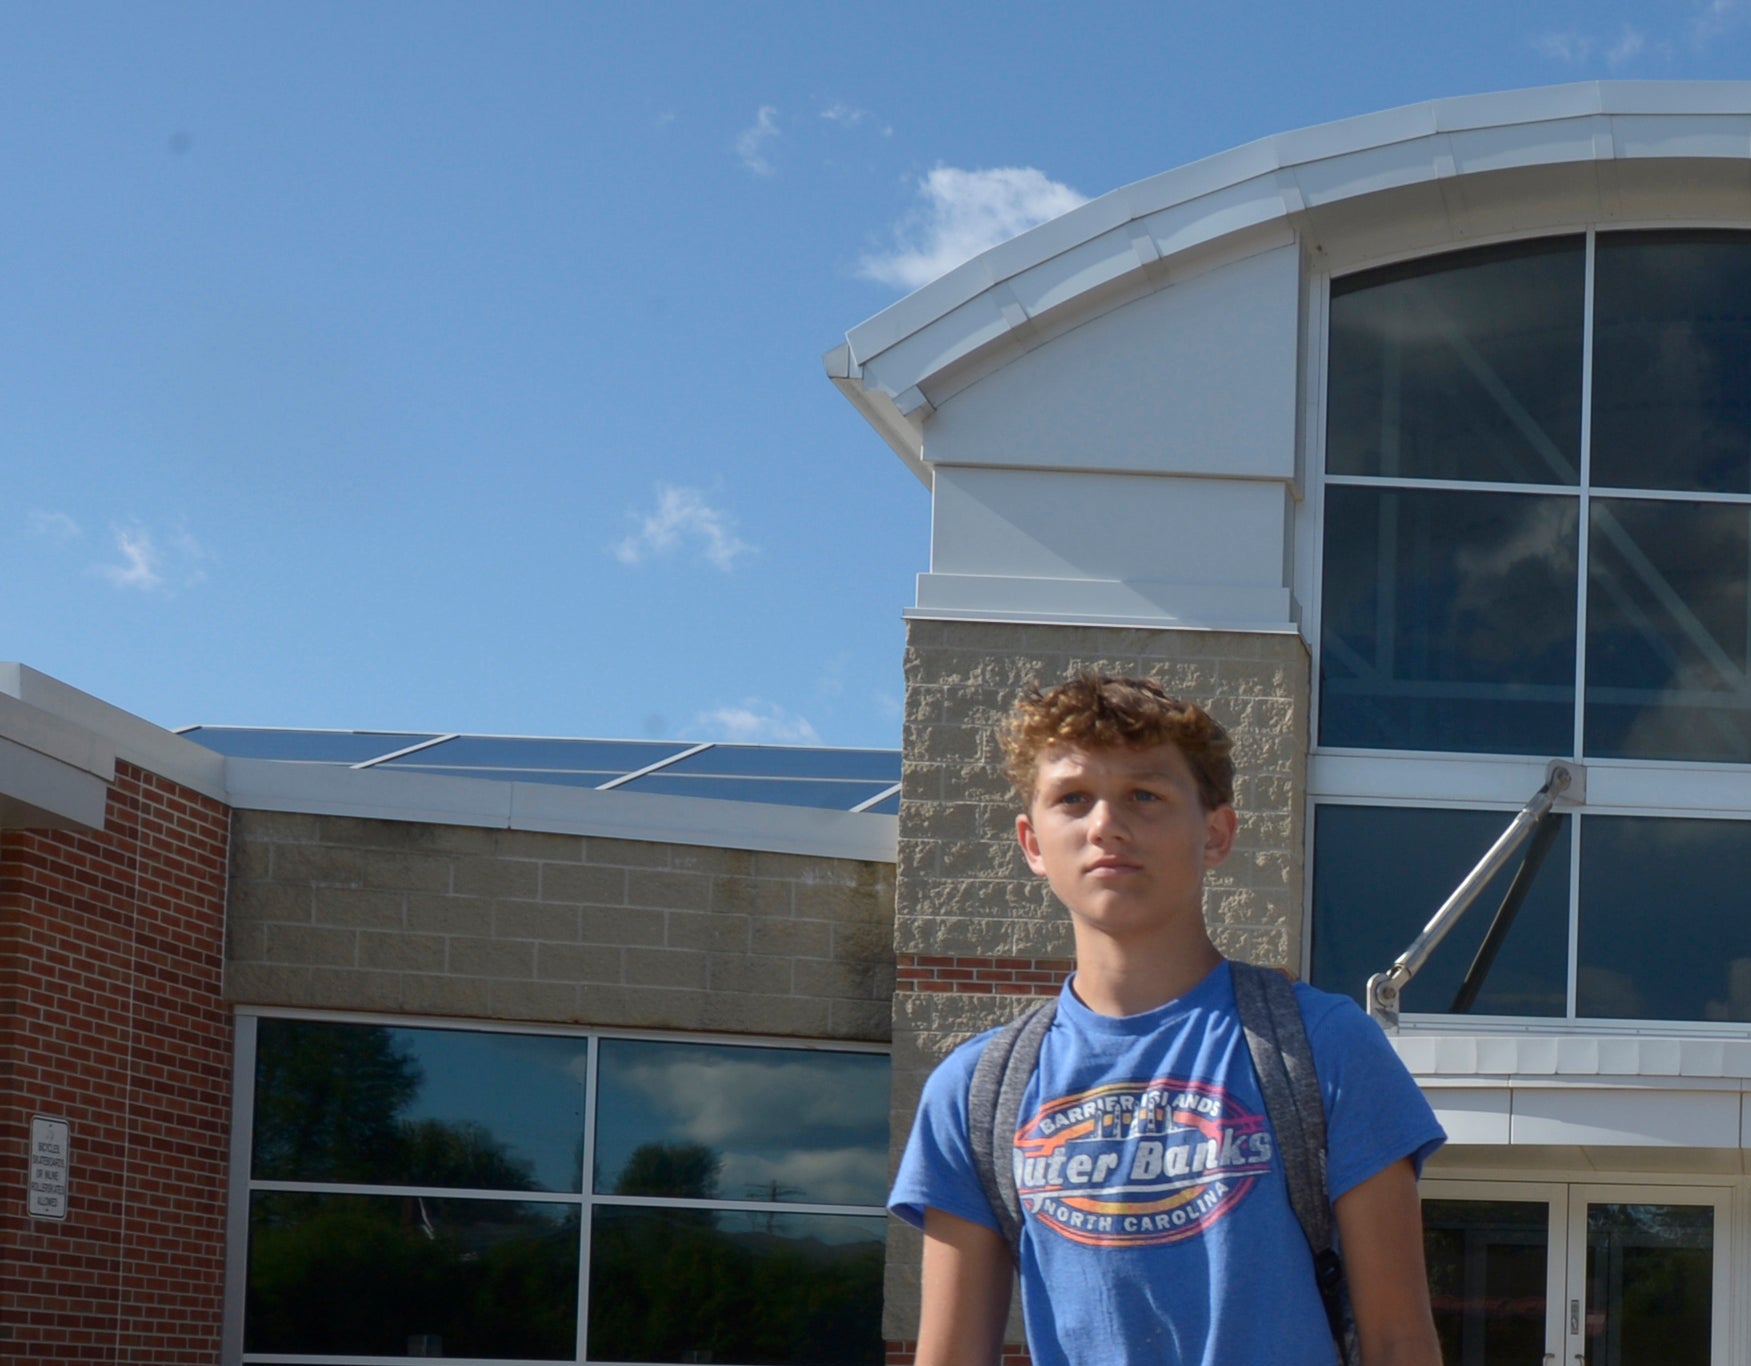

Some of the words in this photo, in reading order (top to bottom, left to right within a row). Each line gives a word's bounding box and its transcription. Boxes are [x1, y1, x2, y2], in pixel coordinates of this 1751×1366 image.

[1039, 1094, 1136, 1135] BARRIER
[1141, 1090, 1221, 1117] ISLANDS
[1130, 1128, 1272, 1180] Banks
[1042, 1197, 1112, 1231] NORTH
[1123, 1180, 1230, 1232] CAROLINA
